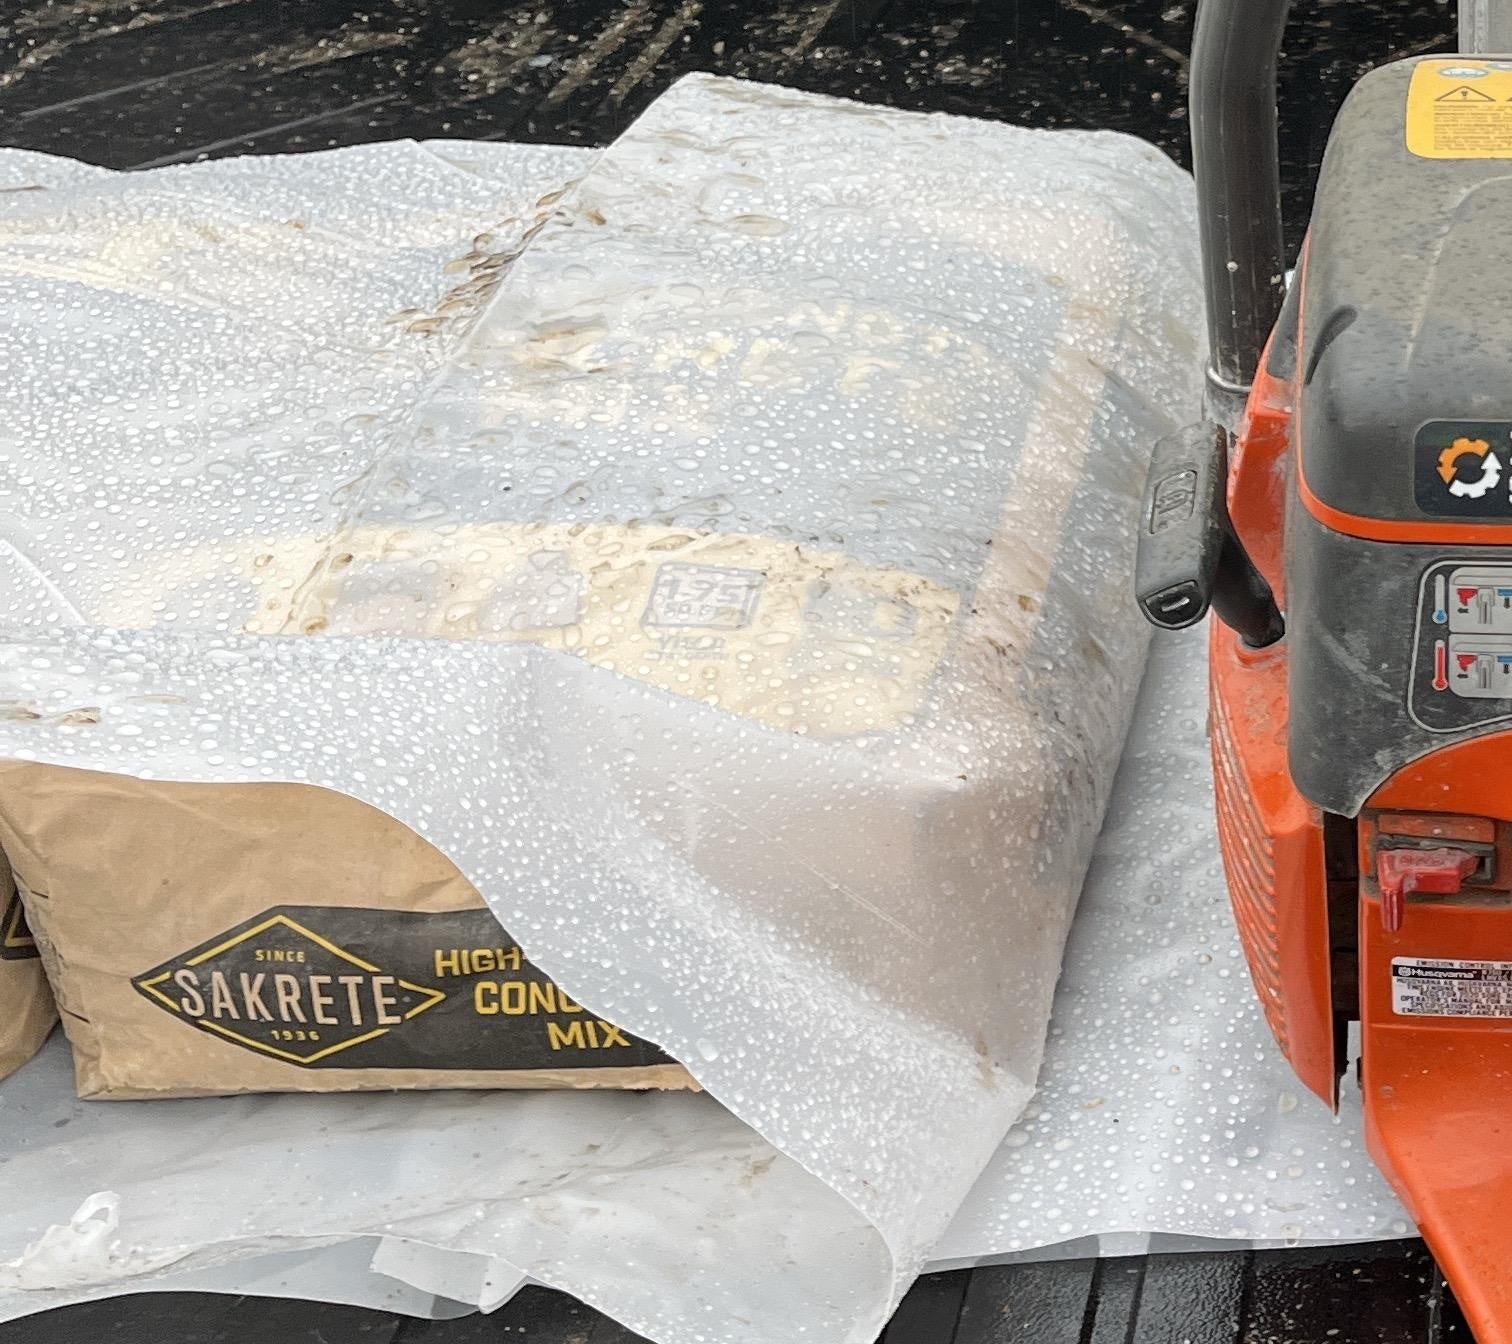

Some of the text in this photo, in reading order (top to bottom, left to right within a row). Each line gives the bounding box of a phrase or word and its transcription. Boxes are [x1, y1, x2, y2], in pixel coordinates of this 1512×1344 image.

[255, 948, 305, 963] SINCE
[1411, 967, 1475, 980] Husqvarna
[173, 968, 402, 1027] SAKRETE
[271, 1029, 321, 1042] 1936
[547, 1020, 632, 1051] MIX
